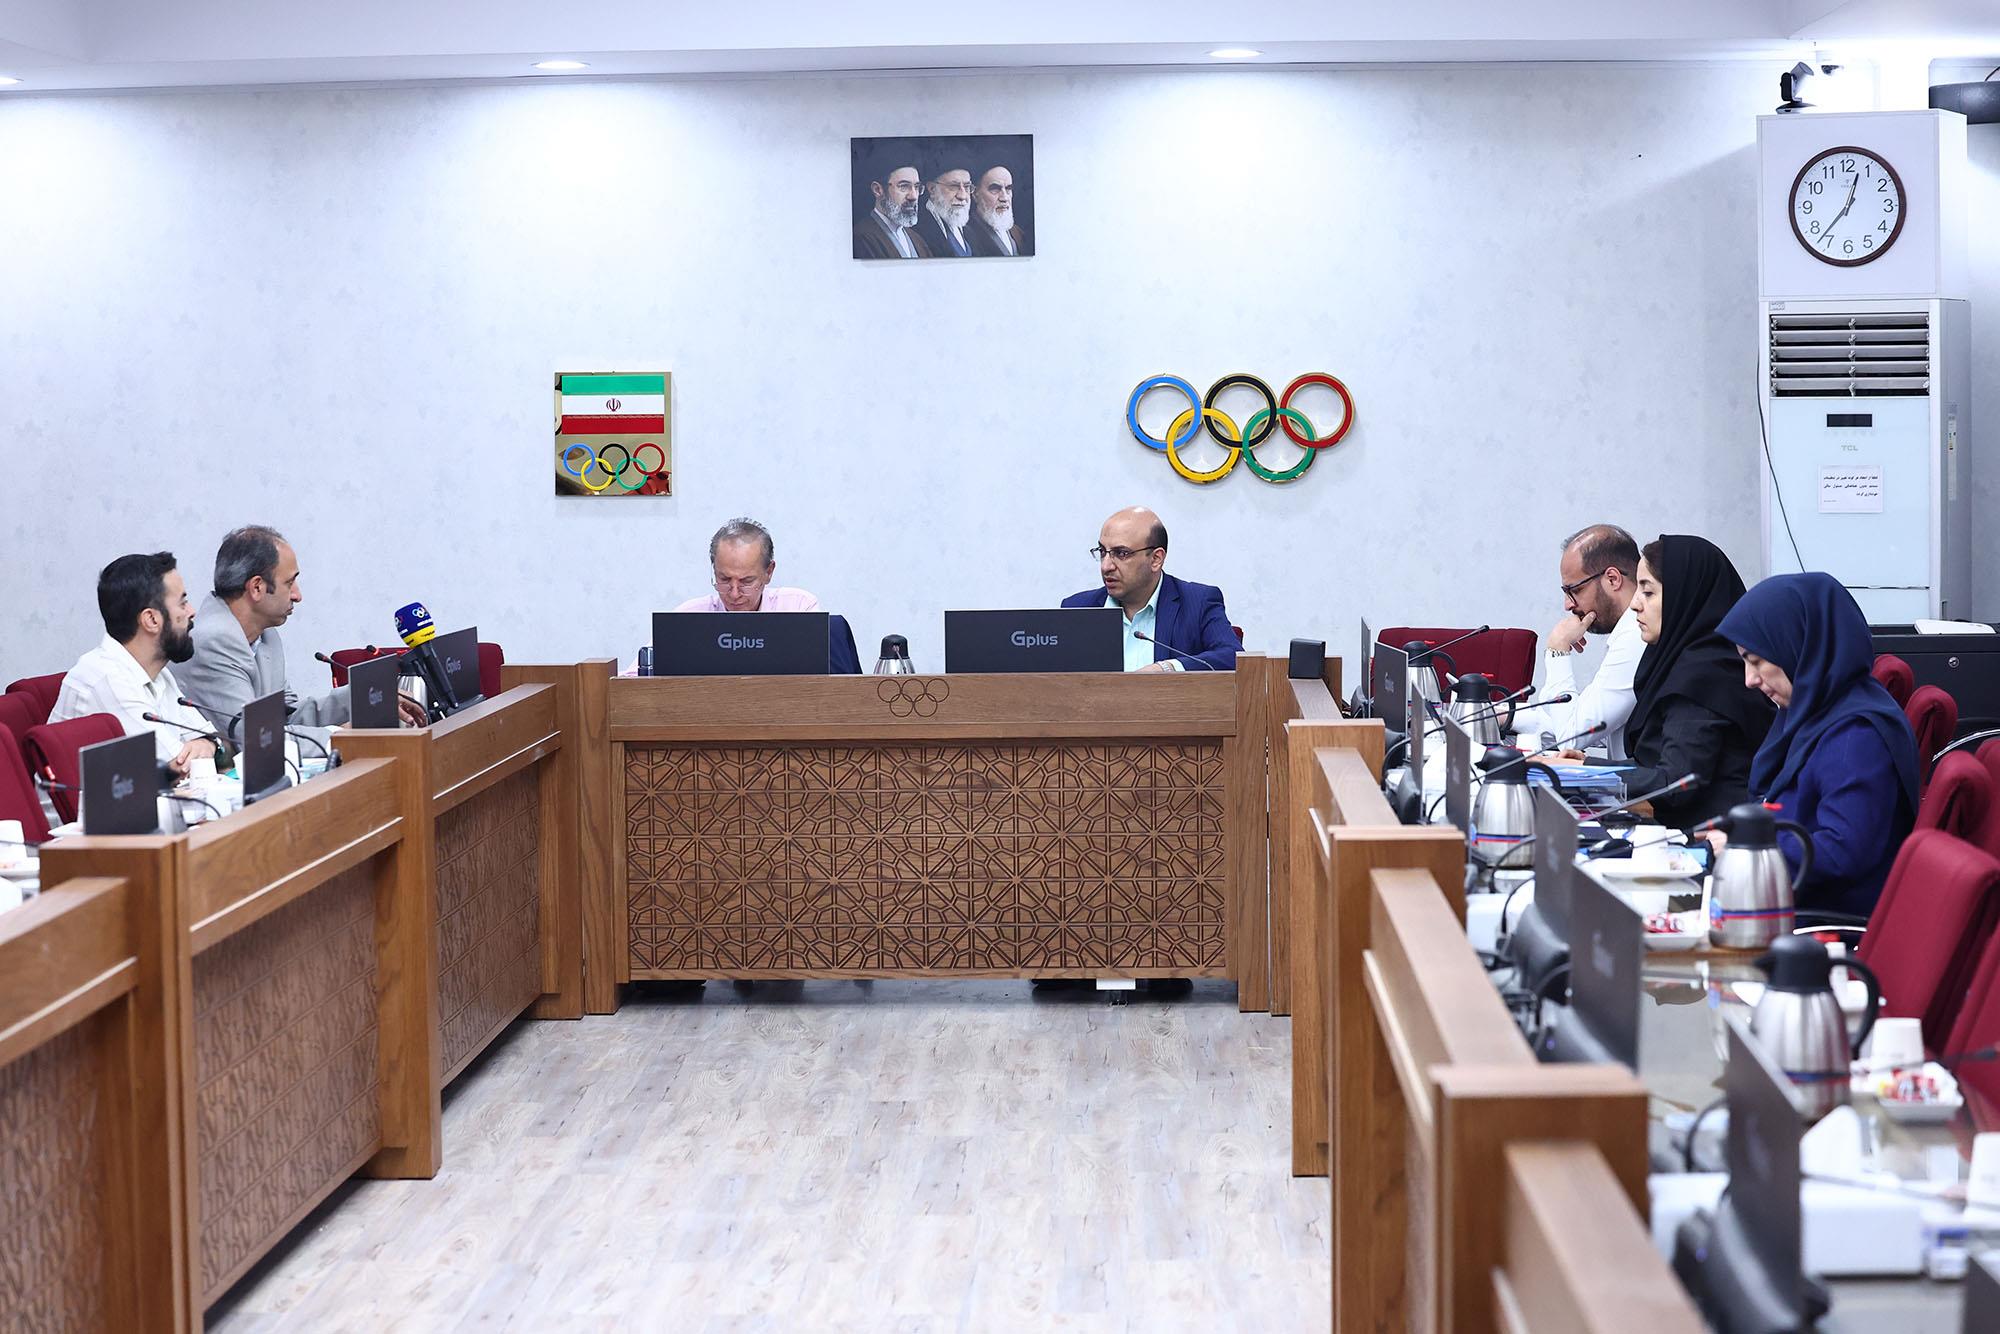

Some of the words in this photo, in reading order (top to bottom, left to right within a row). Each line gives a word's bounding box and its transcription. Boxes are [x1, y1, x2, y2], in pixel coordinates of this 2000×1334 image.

[1822, 165, 1835, 179] 11
[1840, 159, 1856, 173] 12
[1864, 164, 1870, 178] 1
[1808, 181, 1823, 195] 10
[1877, 178, 1888, 192] 2
[1802, 200, 1813, 215] 9
[1883, 198, 1894, 213] 3
[1810, 220, 1820, 234] 8
[1877, 219, 1888, 233] 4
[1825, 234, 1835, 248] 7
[1843, 239, 1854, 254] 6
[1863, 234, 1873, 248] 5
[718, 633, 765, 651] Gplus
[1011, 630, 1058, 648] Gplus
